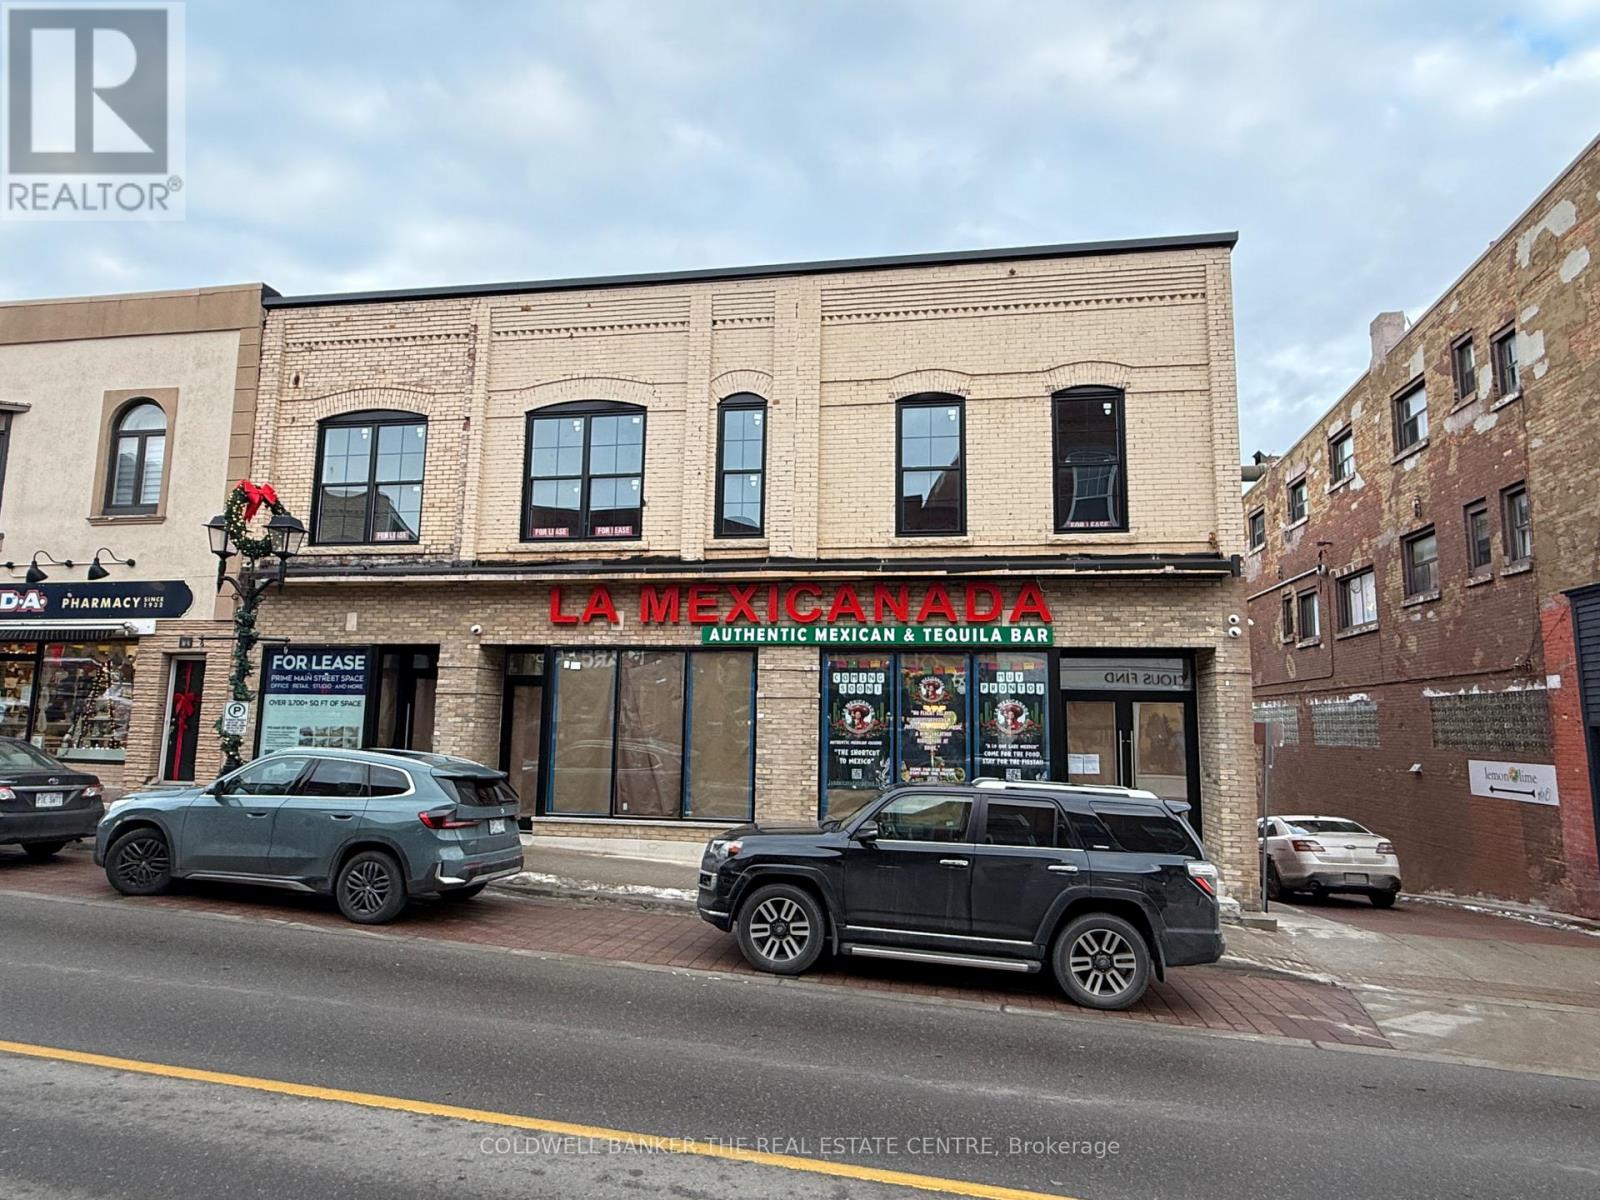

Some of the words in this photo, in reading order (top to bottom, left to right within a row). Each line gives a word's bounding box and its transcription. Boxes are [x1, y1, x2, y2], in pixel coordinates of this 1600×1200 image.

[535, 528, 547, 536] FOR
[598, 527, 609, 535] FOR
[61, 597, 141, 609] PHARMACY
[550, 584, 619, 625] LA
[639, 583, 1053, 625] MEXICANADA
[709, 627, 808, 642] AUTHENTIC
[814, 627, 895, 642] MEXICAN
[903, 628, 915, 642] &
[923, 627, 1002, 643] TEQUILA
[1010, 628, 1048, 642] BAR
[272, 655, 307, 670] FOR
[311, 655, 366, 670] LEASE
[270, 674, 292, 682] PRIME
[293, 674, 312, 682] MAIN
[313, 673, 339, 682] STREET
[833, 672, 885, 683] COMING
[996, 672, 1023, 682] MUY
[233, 706, 242, 715] P
[1484, 767, 1510, 782] lemon
[1518, 769, 1537, 784] lime
